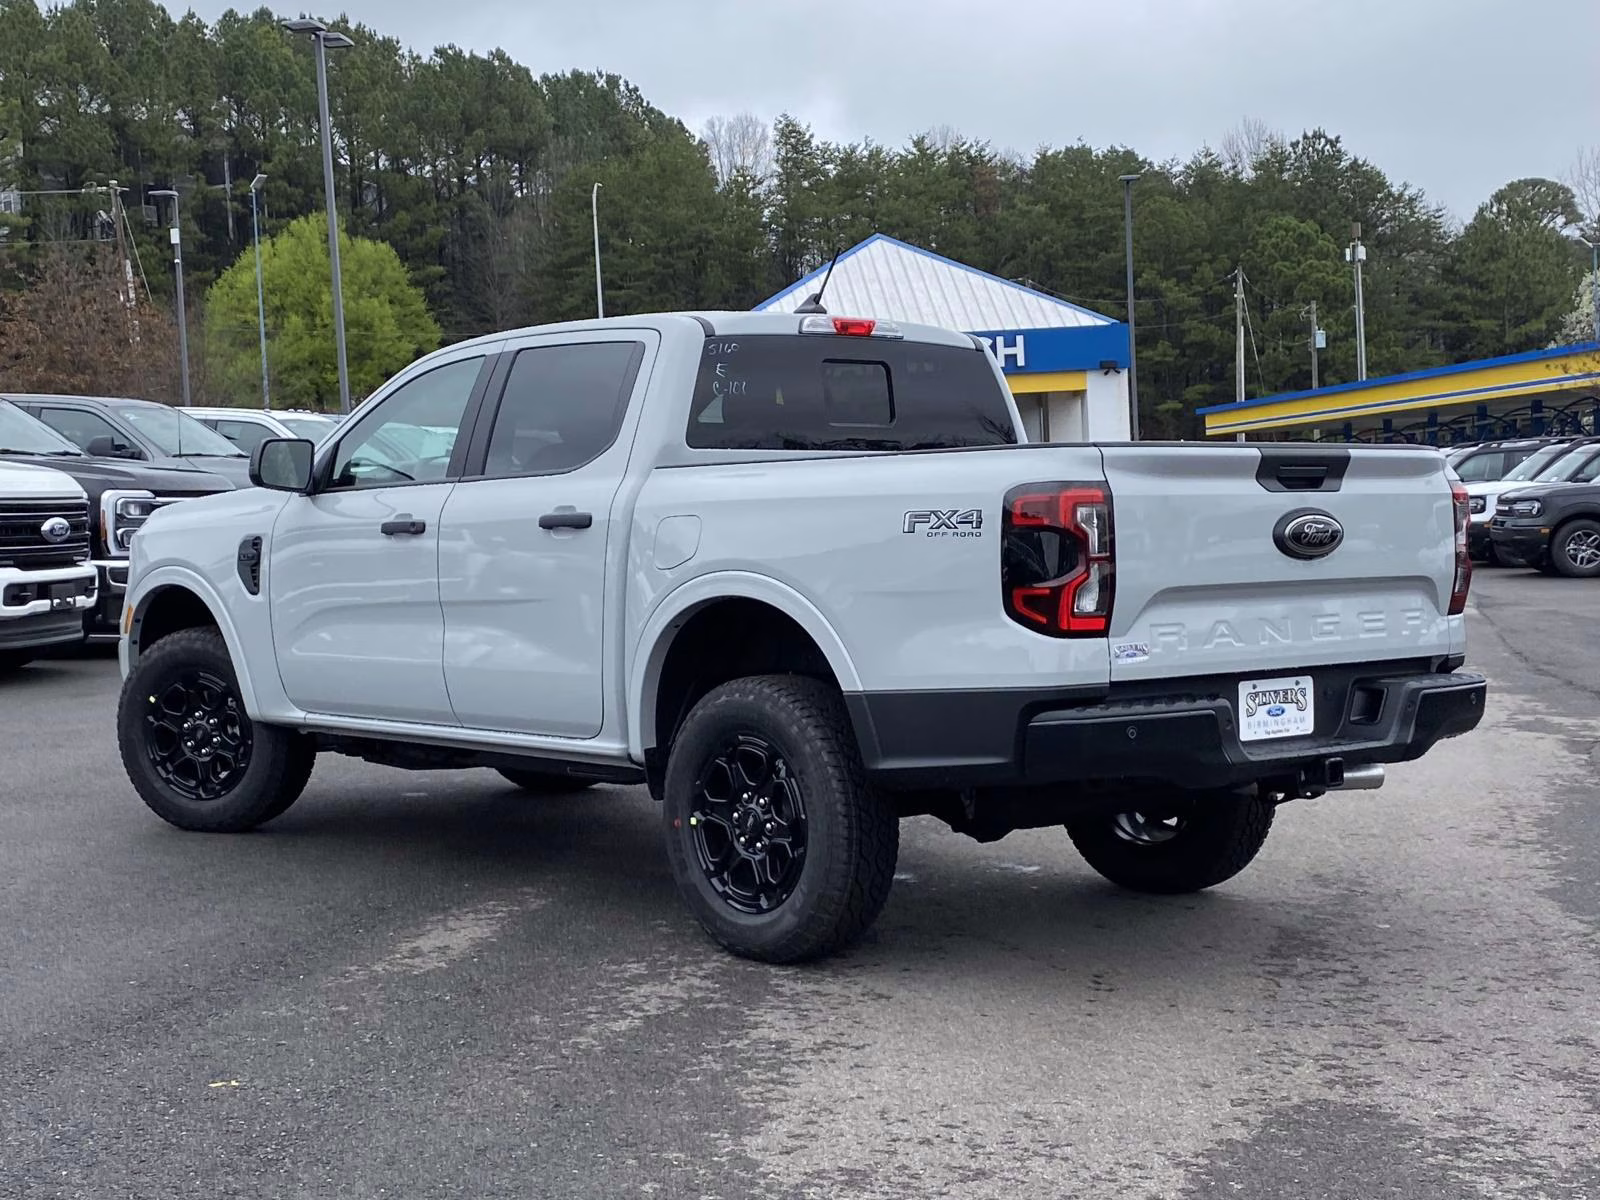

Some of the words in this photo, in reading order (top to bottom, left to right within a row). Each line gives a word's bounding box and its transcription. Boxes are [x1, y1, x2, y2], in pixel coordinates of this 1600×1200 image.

[902, 509, 983, 533] FX4
[1301, 522, 1332, 544] Ford
[1150, 608, 1428, 652] RANGER
[1245, 687, 1308, 718] STIVERS
